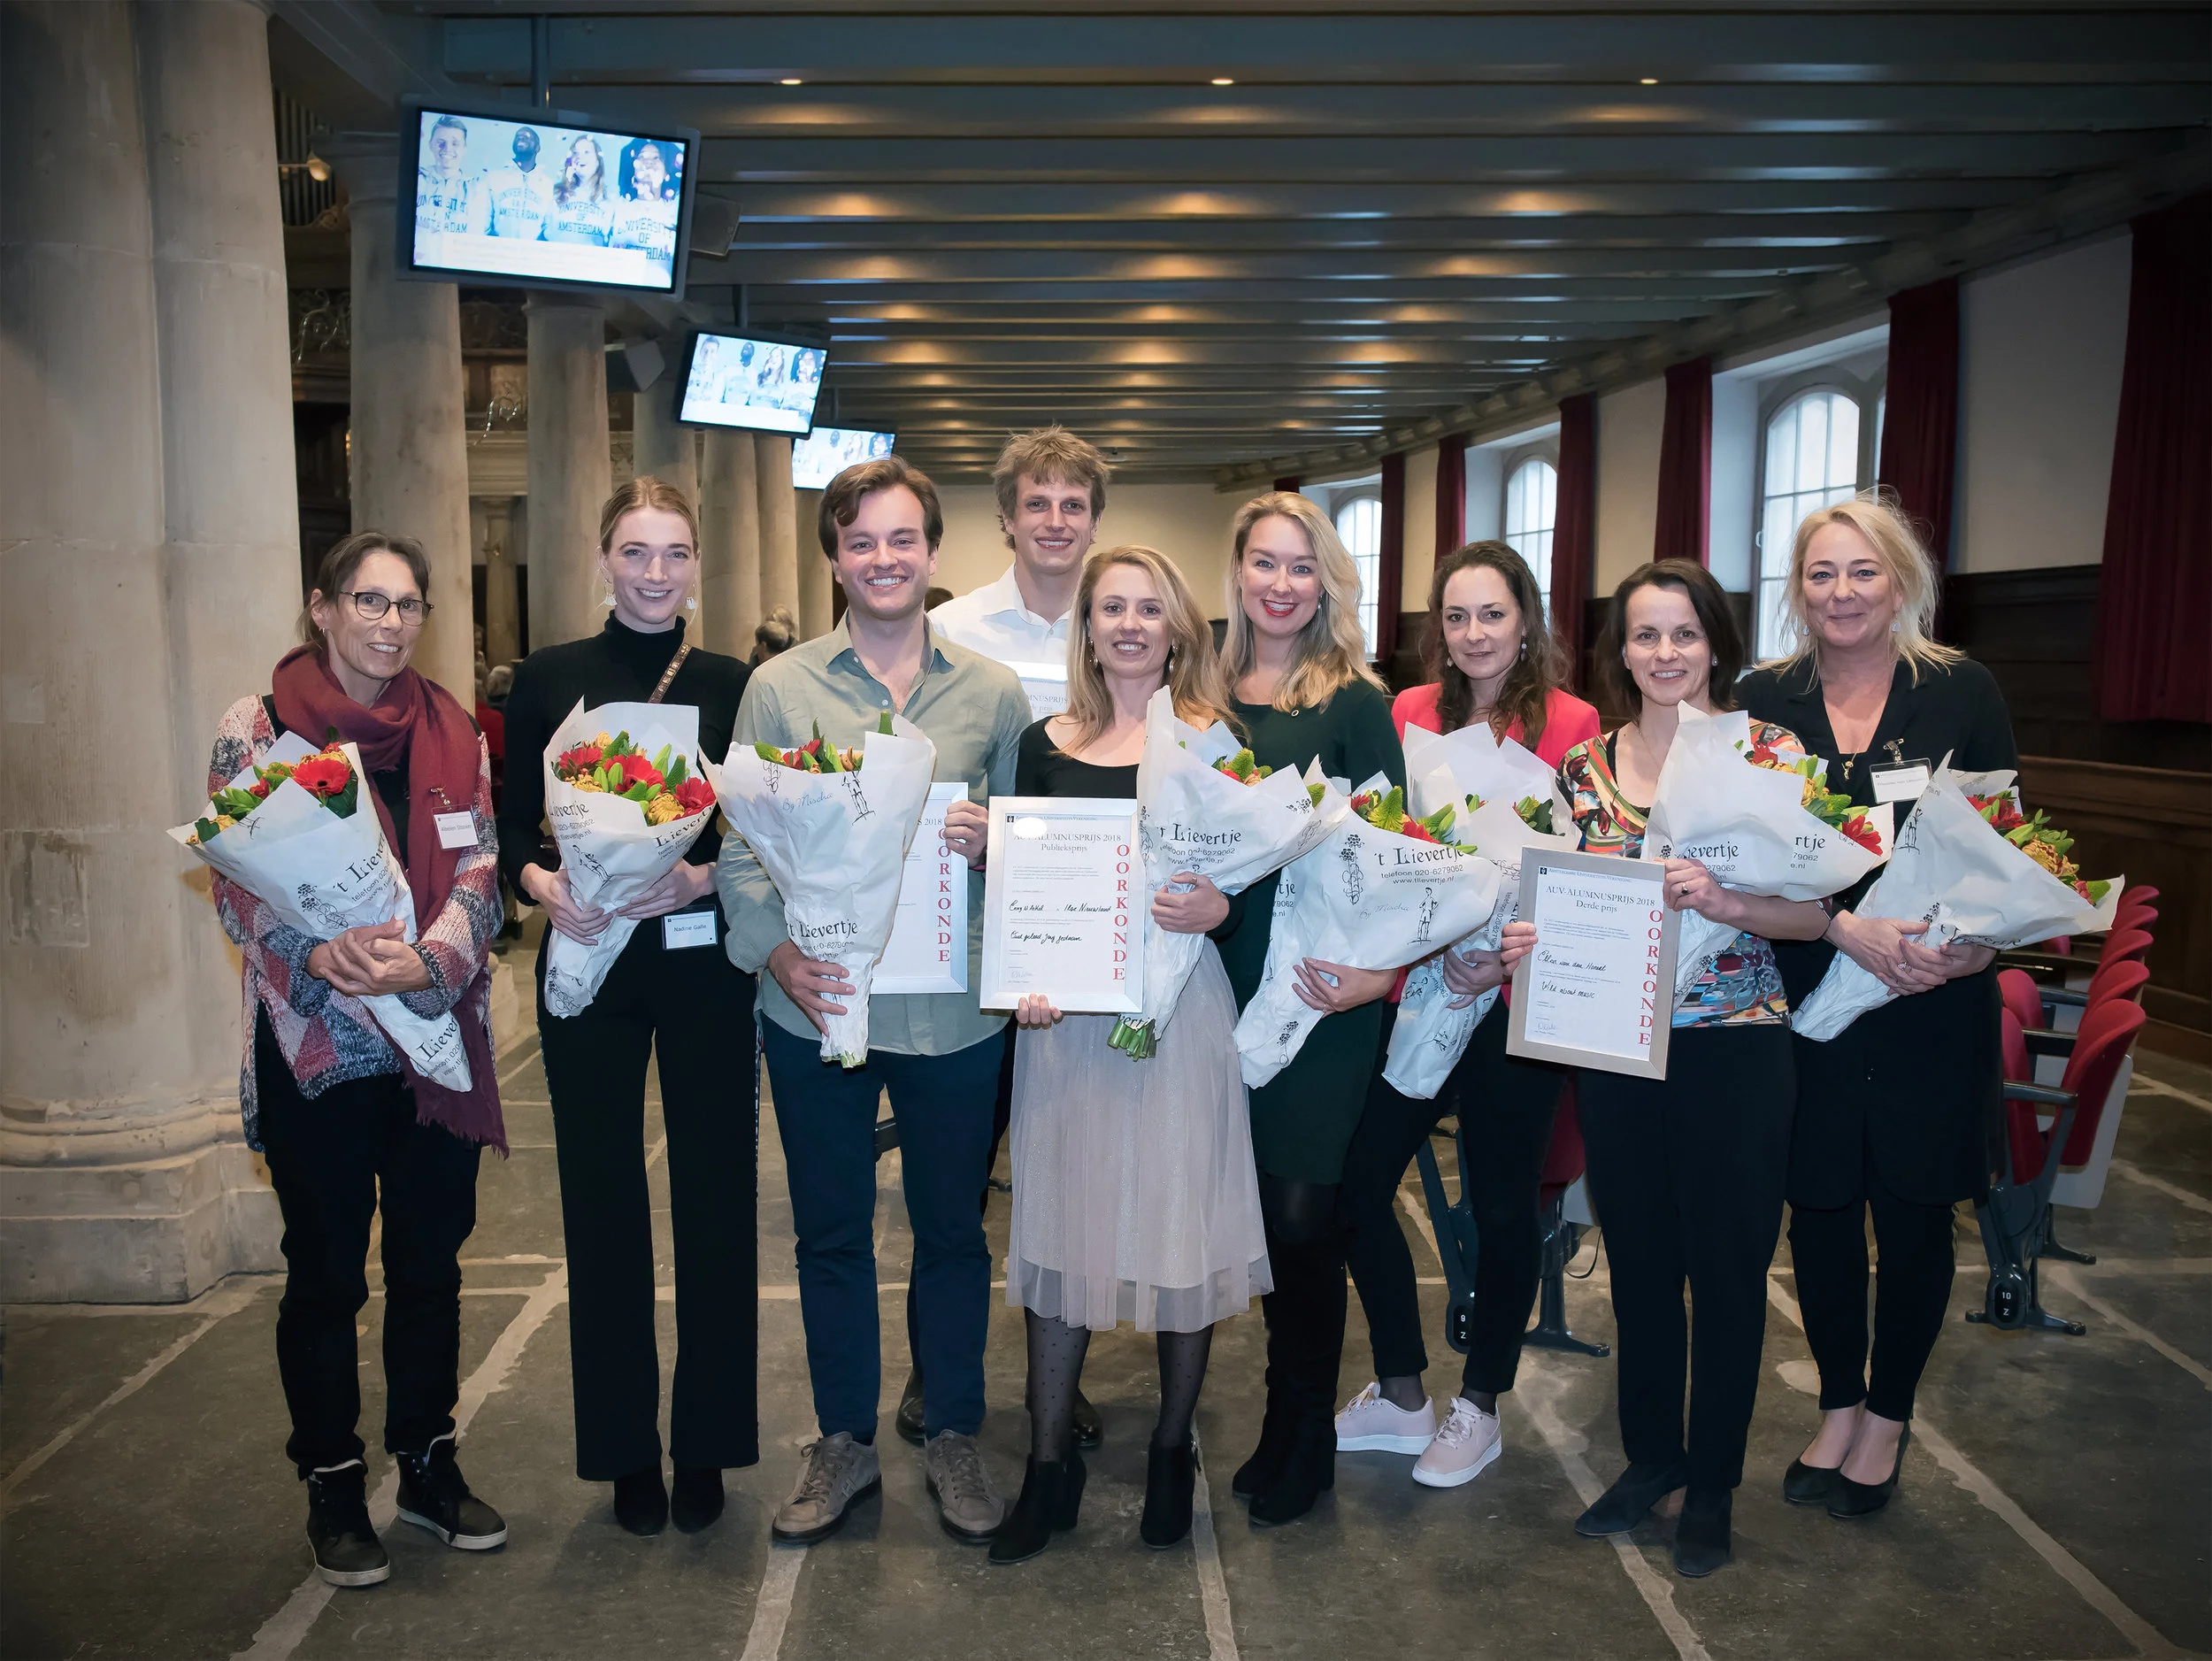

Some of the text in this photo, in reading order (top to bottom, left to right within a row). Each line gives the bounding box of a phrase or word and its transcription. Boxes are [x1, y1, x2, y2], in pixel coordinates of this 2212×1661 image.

[558, 201, 605, 219] UNIVERSITY
[557, 222, 604, 236] AMSTERDAM
[638, 232, 651, 244] OF
[1170, 822, 1242, 848] Lievertje
[1041, 843, 1087, 854] Publieksprijs
[1373, 852, 1386, 866] 't
[1380, 865, 1464, 879] telefoon 020-6279062
[1546, 885, 1655, 906] AUV-ALUMNUSPRIJS 2018
[1576, 899, 1618, 913] Derde prijs
[2001, 1291, 2012, 1300] 10
[2002, 1307, 2009, 1316] Z
